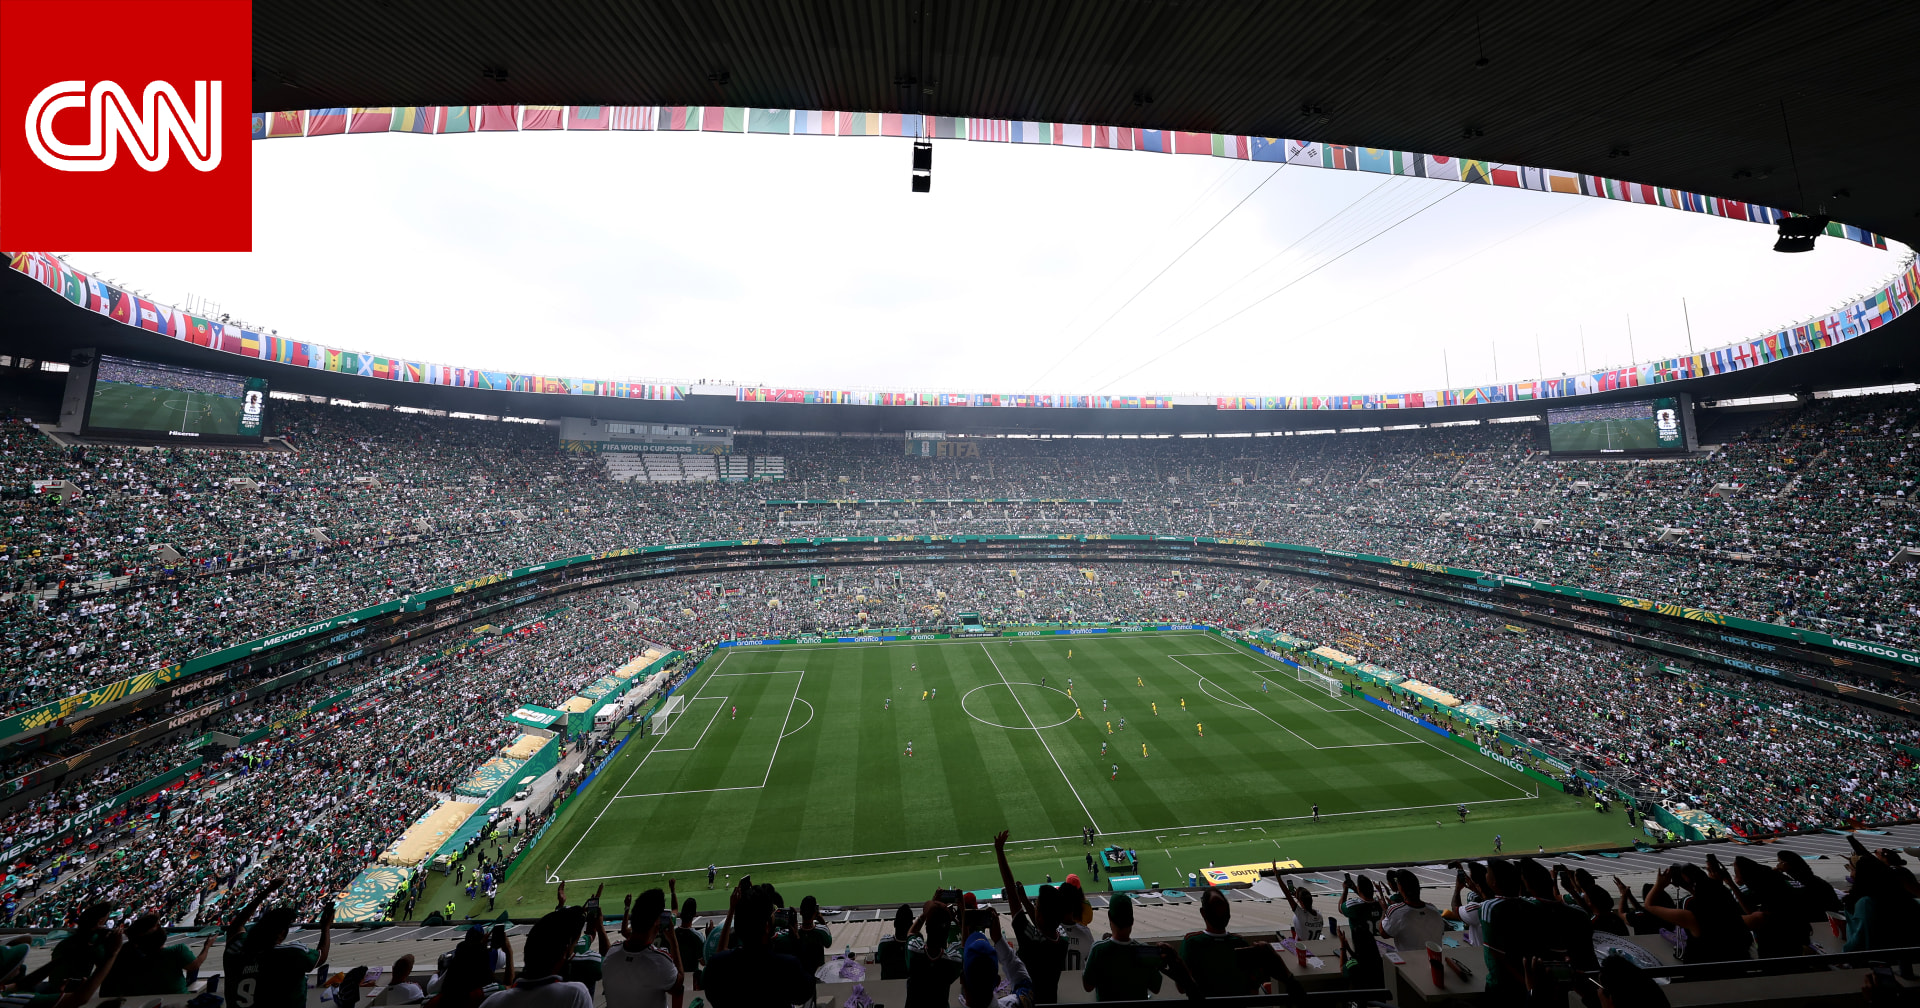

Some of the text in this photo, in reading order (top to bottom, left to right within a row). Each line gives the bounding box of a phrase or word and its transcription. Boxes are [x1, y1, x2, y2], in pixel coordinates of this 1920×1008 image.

[620, 444, 648, 452] WORLD
[534, 615, 546, 623] CITY
[1593, 608, 1610, 616] OFF
[263, 622, 332, 647] MEXICO CITY
[330, 628, 365, 644] KICK OFF
[1574, 624, 1612, 637] KICK OFF
[1721, 635, 1776, 652] KICK OFF
[1832, 639, 1920, 663] MEXICO CI
[328, 650, 363, 667] KIK OFF
[1264, 650, 1284, 662] aramco
[1724, 658, 1780, 676] KICK OFF
[171, 674, 226, 697] KICK OFF
[168, 702, 223, 729] KICK OFF
[1387, 704, 1419, 724] aramco
[1834, 725, 1873, 741] CITY
[1480, 746, 1523, 772] aramco
[74, 798, 116, 824] CITY
[530, 813, 556, 848] aramco
